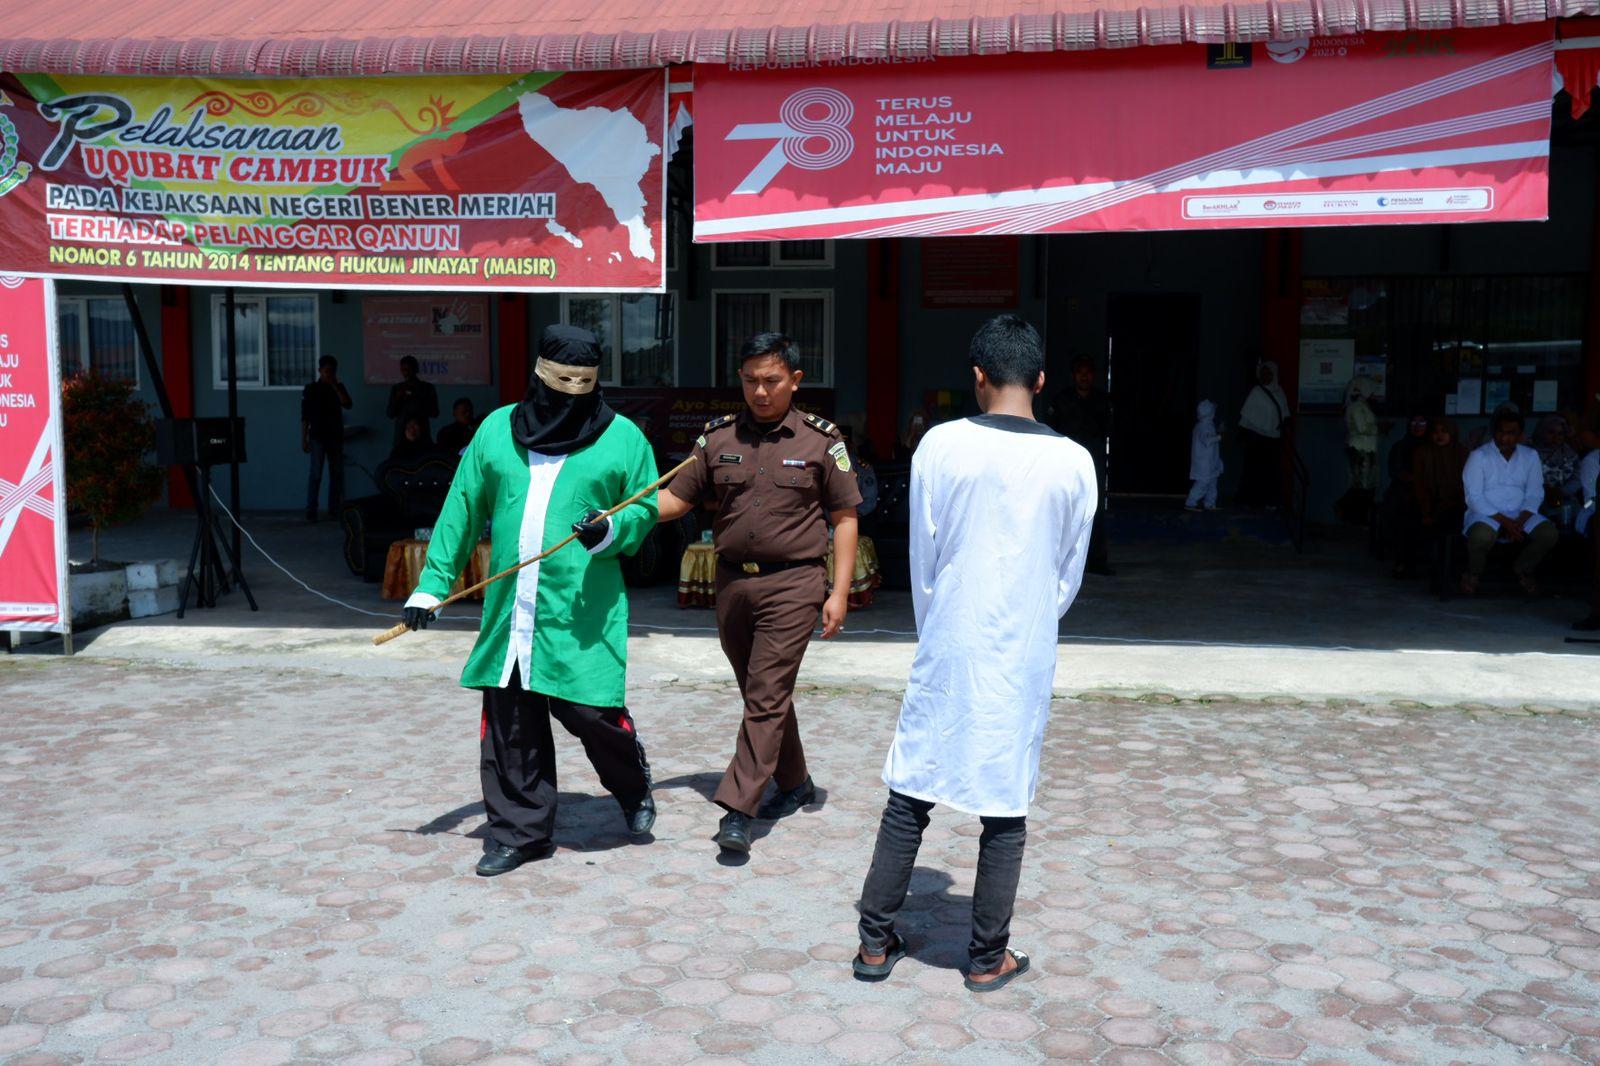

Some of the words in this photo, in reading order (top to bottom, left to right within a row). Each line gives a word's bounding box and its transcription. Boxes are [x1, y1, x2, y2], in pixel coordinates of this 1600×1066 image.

[876, 96, 953, 111] TERUS
[876, 111, 972, 126] MELAJU
[41, 95, 341, 168] Pelaksanaan
[876, 128, 955, 143] UNTUK
[876, 143, 1004, 159] INDONESIA
[83, 149, 222, 183] UQUBAT
[229, 156, 389, 183] CAMBUK
[876, 161, 942, 175] MAJU
[49, 186, 115, 209] PADA
[124, 190, 262, 216] KEJAKSAAN
[270, 195, 360, 218] NEGERI
[370, 194, 453, 217] BENER
[460, 194, 554, 217] MERIAH
[50, 216, 185, 243] TERHADAP
[194, 224, 352, 248] PELANGGAR
[357, 225, 459, 251] QANUN
[50, 246, 121, 266] NOMOR
[126, 249, 136, 267] 6
[142, 250, 203, 269] TAHUN
[208, 253, 250, 271] 2014
[255, 254, 335, 273] TENTANG
[340, 256, 406, 275] HUKUM
[410, 256, 479, 275] JINAYAT
[483, 256, 557, 280] (MAISIR)
[0, 393, 36, 407] NESIA
